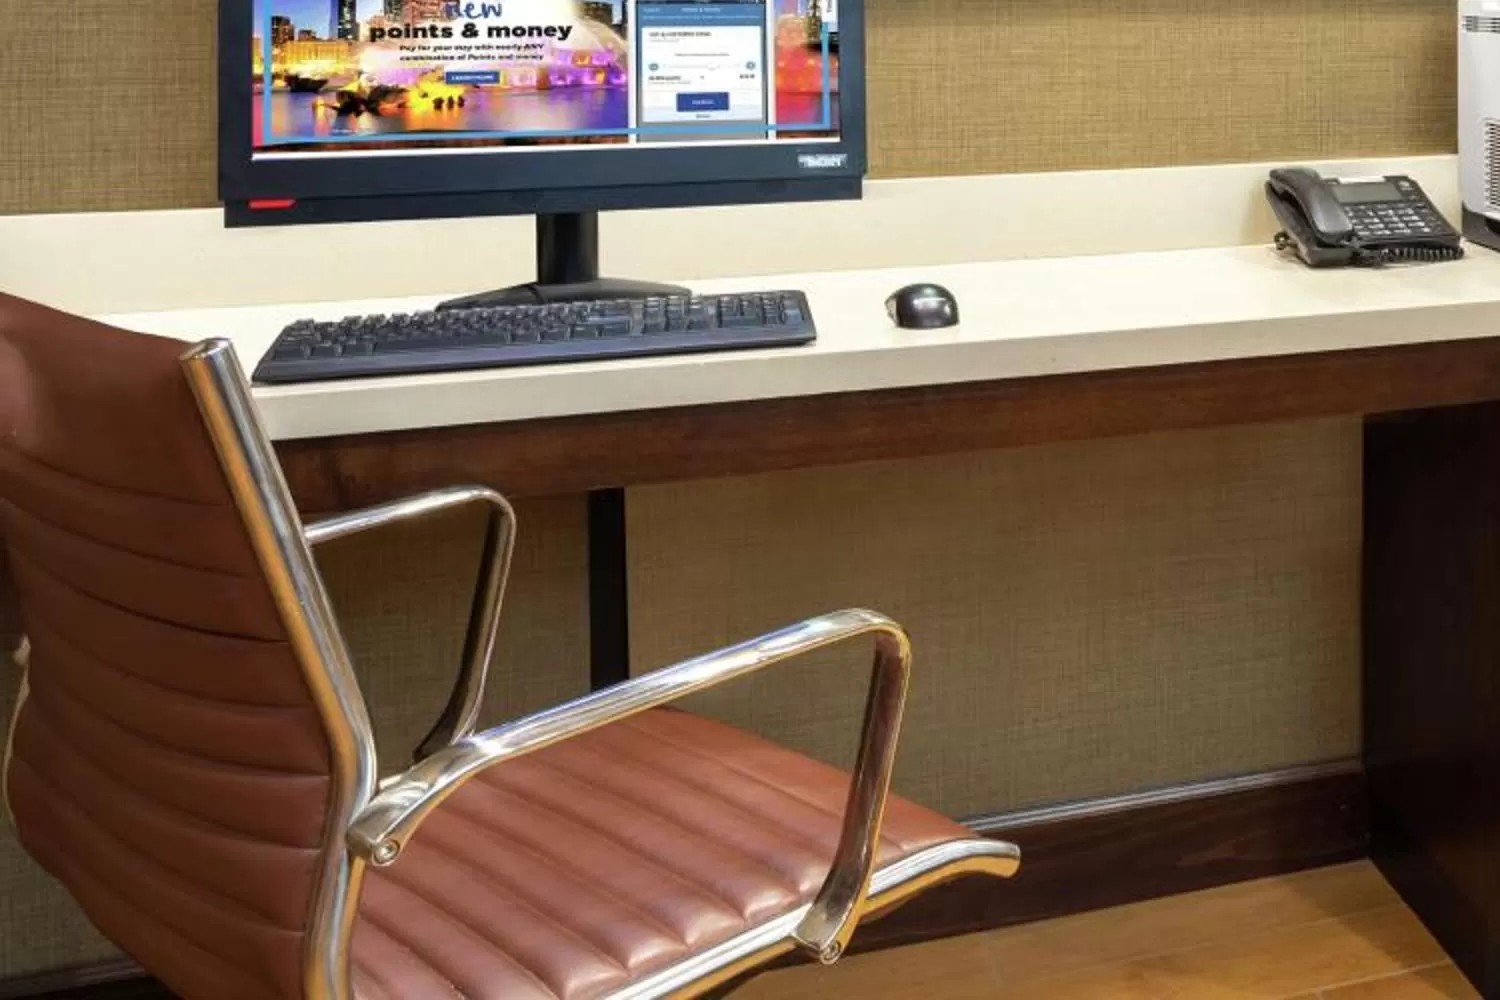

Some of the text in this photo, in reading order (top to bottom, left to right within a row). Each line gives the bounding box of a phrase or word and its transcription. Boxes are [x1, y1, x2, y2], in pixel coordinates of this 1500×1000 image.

[444, 0, 503, 19] new
[369, 22, 574, 42] points & money
